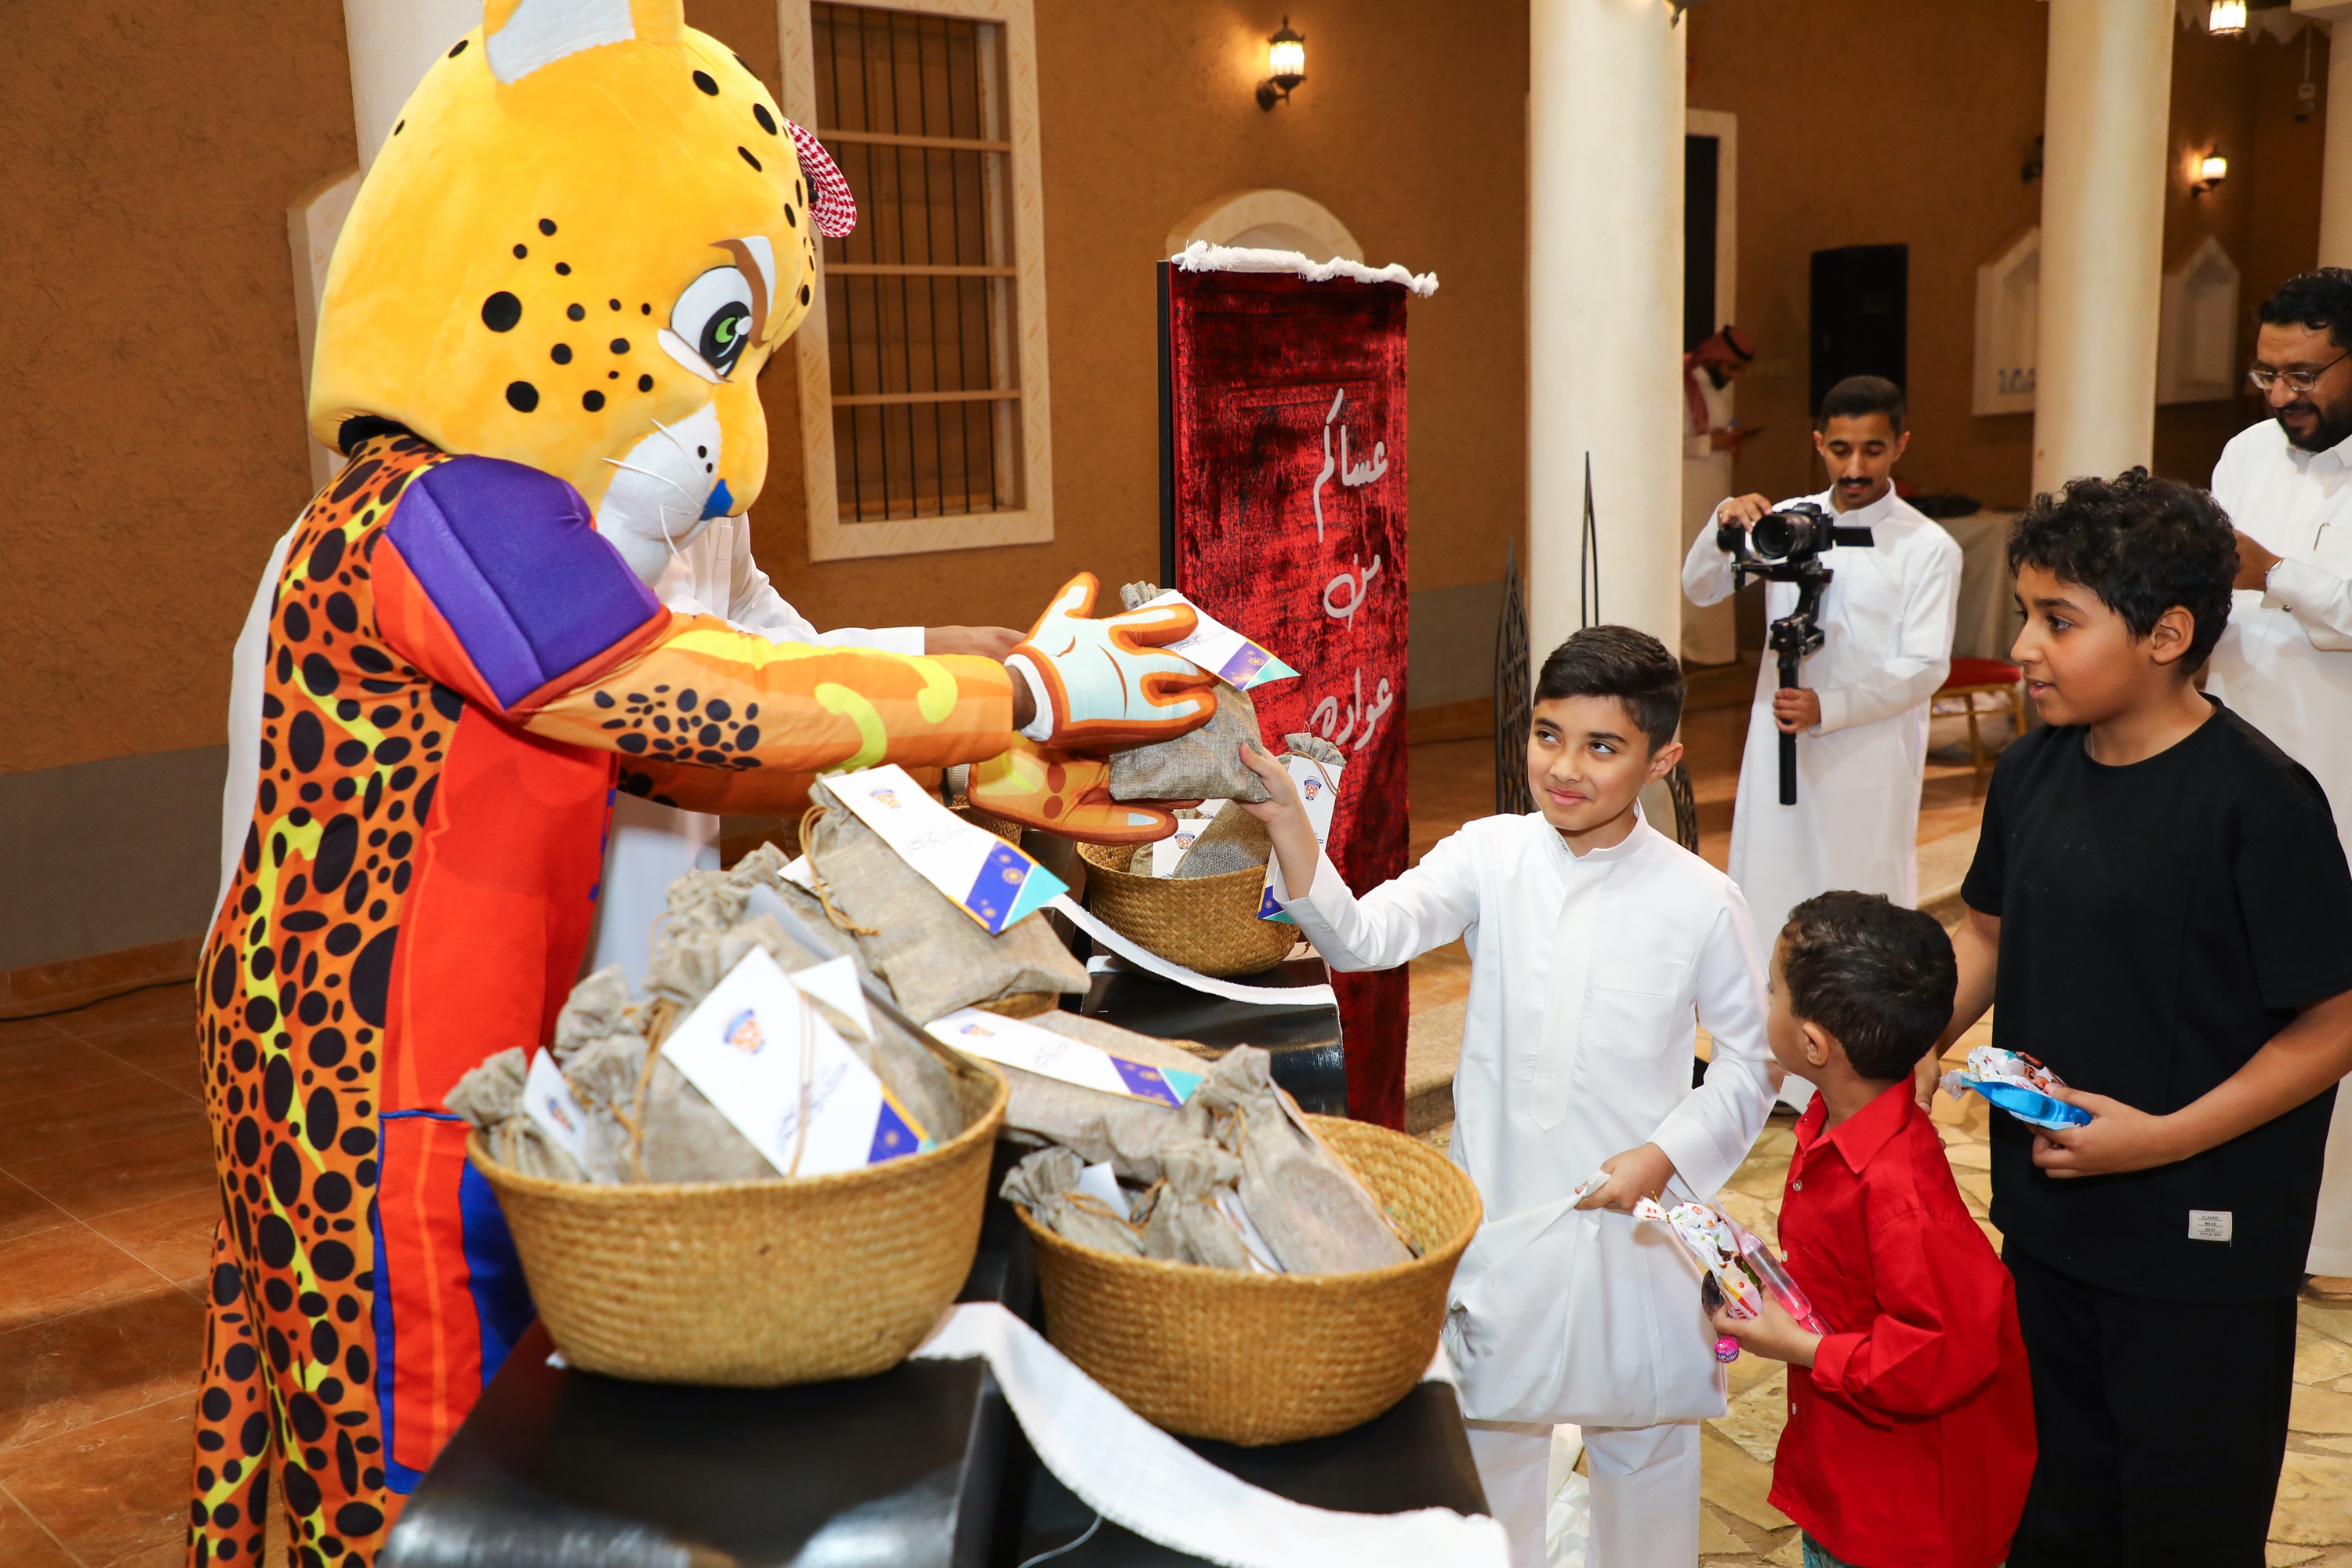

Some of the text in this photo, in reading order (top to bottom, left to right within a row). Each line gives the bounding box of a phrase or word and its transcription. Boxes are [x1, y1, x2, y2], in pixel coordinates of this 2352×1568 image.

[1313, 387, 1388, 543] عساكم
[1323, 553, 1381, 632] من
[1310, 666, 1394, 752] عواده
